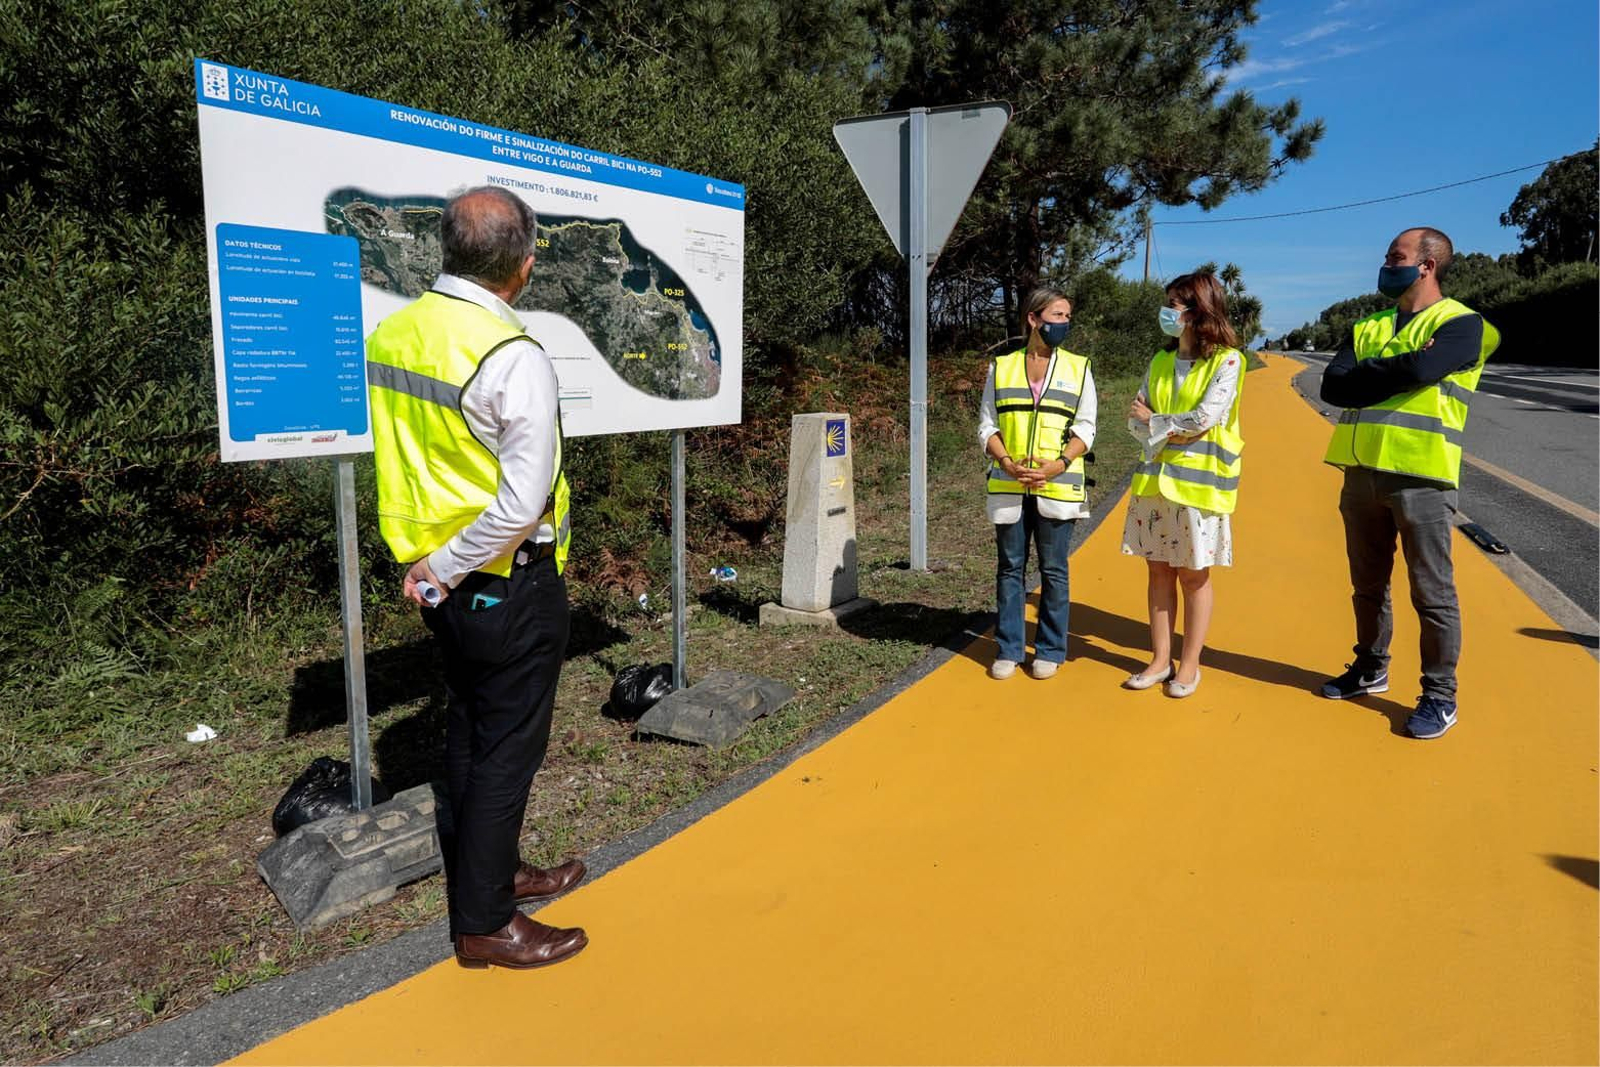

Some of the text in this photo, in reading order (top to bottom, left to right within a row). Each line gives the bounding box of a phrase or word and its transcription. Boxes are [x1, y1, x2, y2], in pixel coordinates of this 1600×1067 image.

[234, 73, 289, 96] XUNTA
[235, 87, 322, 117] DE GALICIA
[390, 109, 662, 178] RENOVACIÓN DO FIRME E SINALIZACIÓN DO CARRIL BICI NA PO-552
[492, 145, 592, 174] ENTRE VIGO E A GUARDA
[487, 174, 545, 193] INVESTIMENTO
[380, 228, 387, 236] A
[224, 240, 282, 251] DATOS TÉCNICOS
[536, 238, 550, 248] 552
[228, 296, 262, 304] UNIDADES
